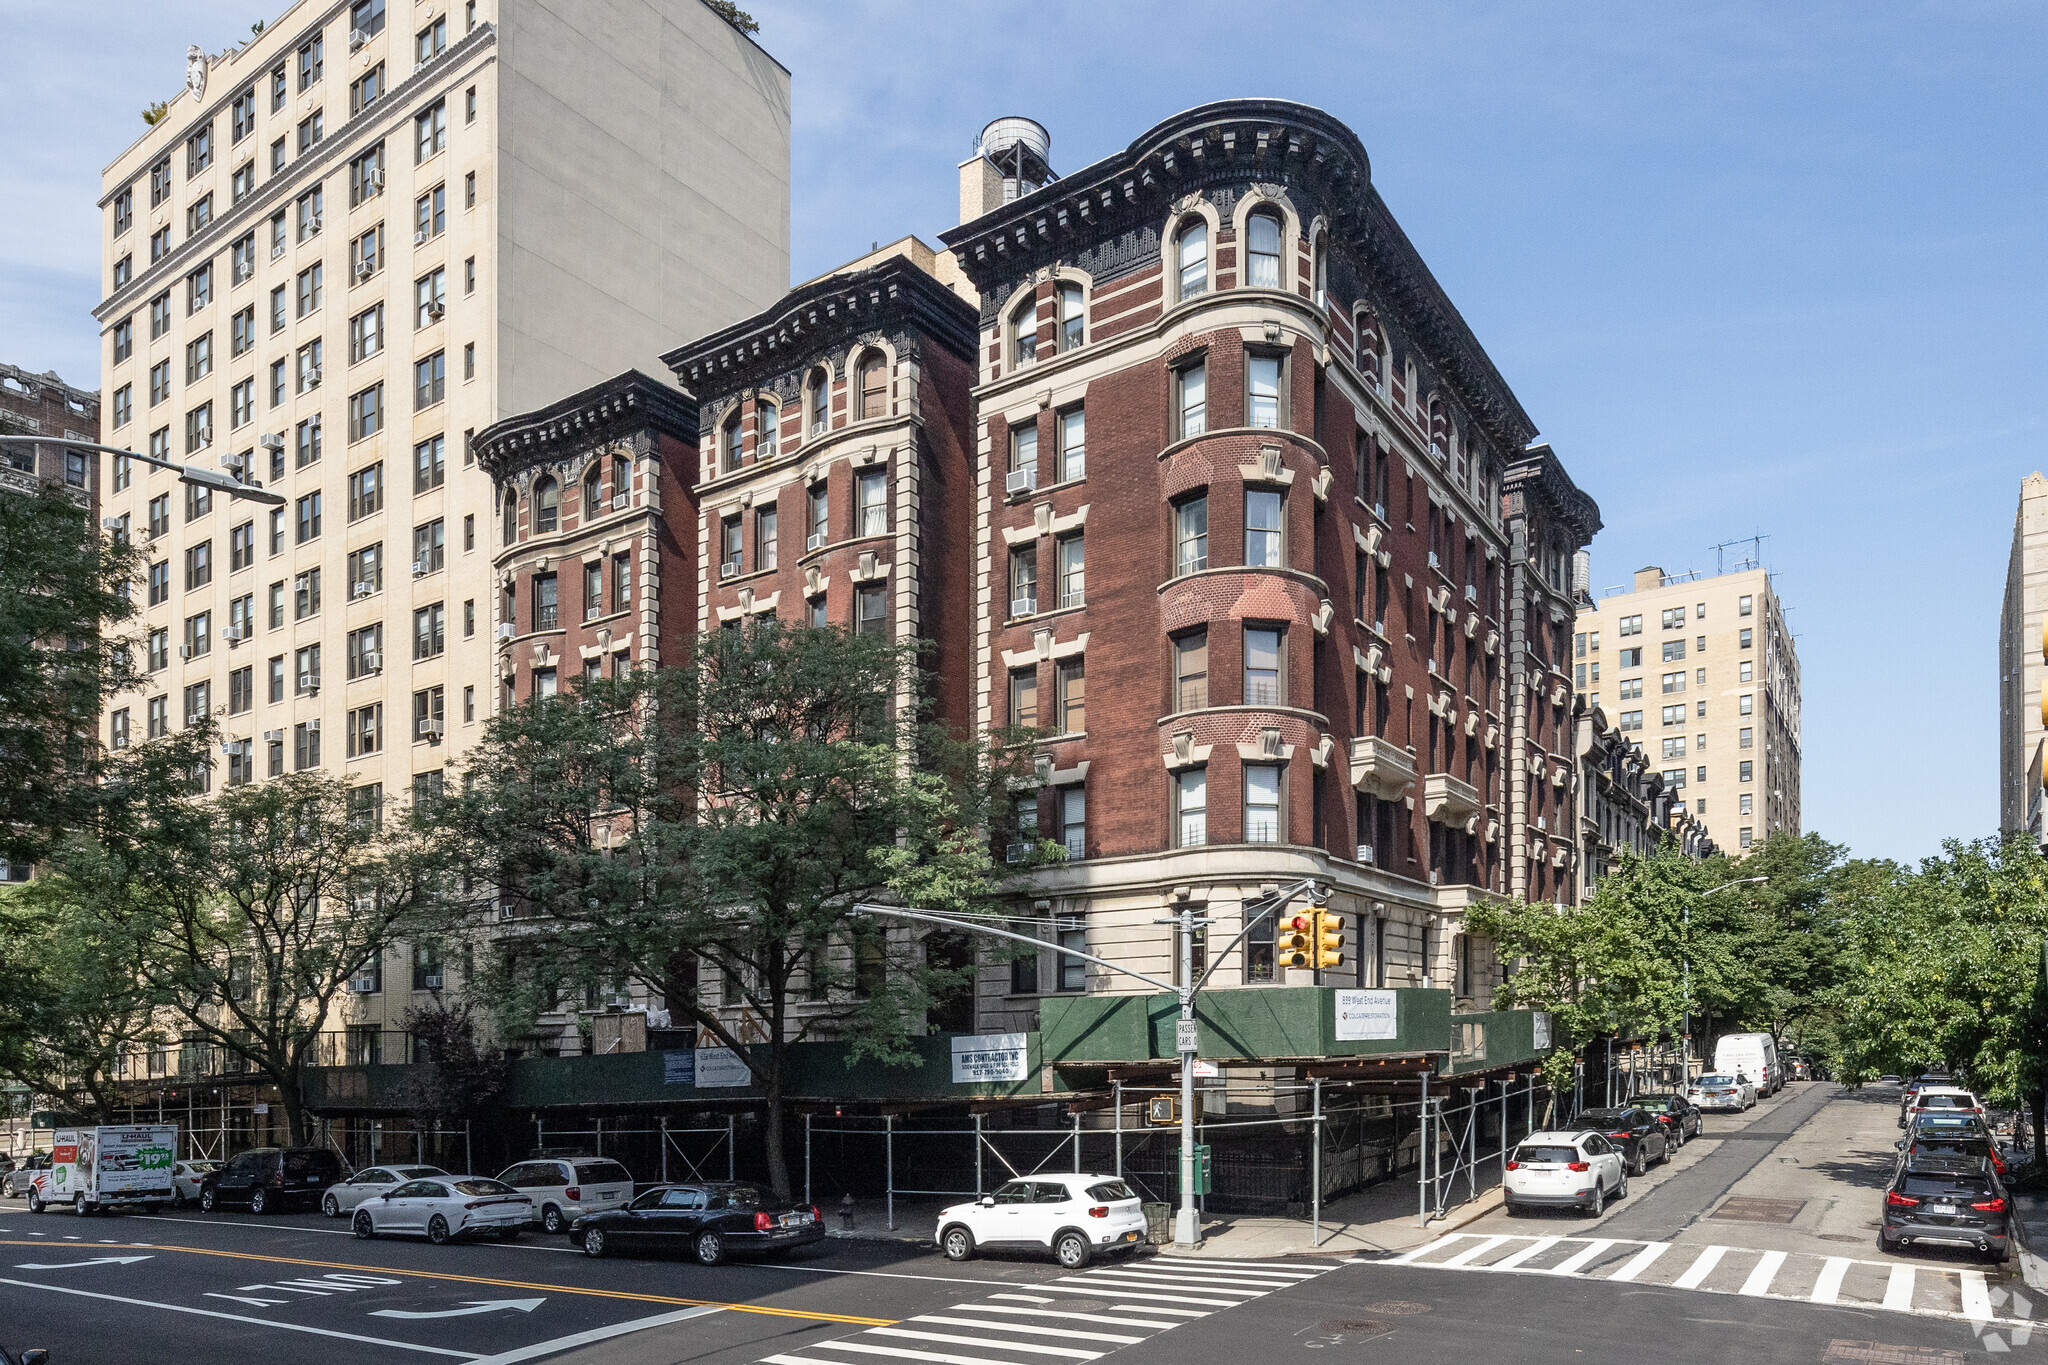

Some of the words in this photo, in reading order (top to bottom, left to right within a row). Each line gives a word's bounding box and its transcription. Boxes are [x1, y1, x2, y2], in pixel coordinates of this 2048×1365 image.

[1352, 996, 1363, 1005] West
[1365, 996, 1373, 1005] End
[1374, 996, 1391, 1005] Avenue
[1179, 1036, 1191, 1045] CARS
[962, 1054, 972, 1063] AMS
[974, 1051, 1008, 1062] CONTRACTOR
[56, 1135, 76, 1143] U-HAUL
